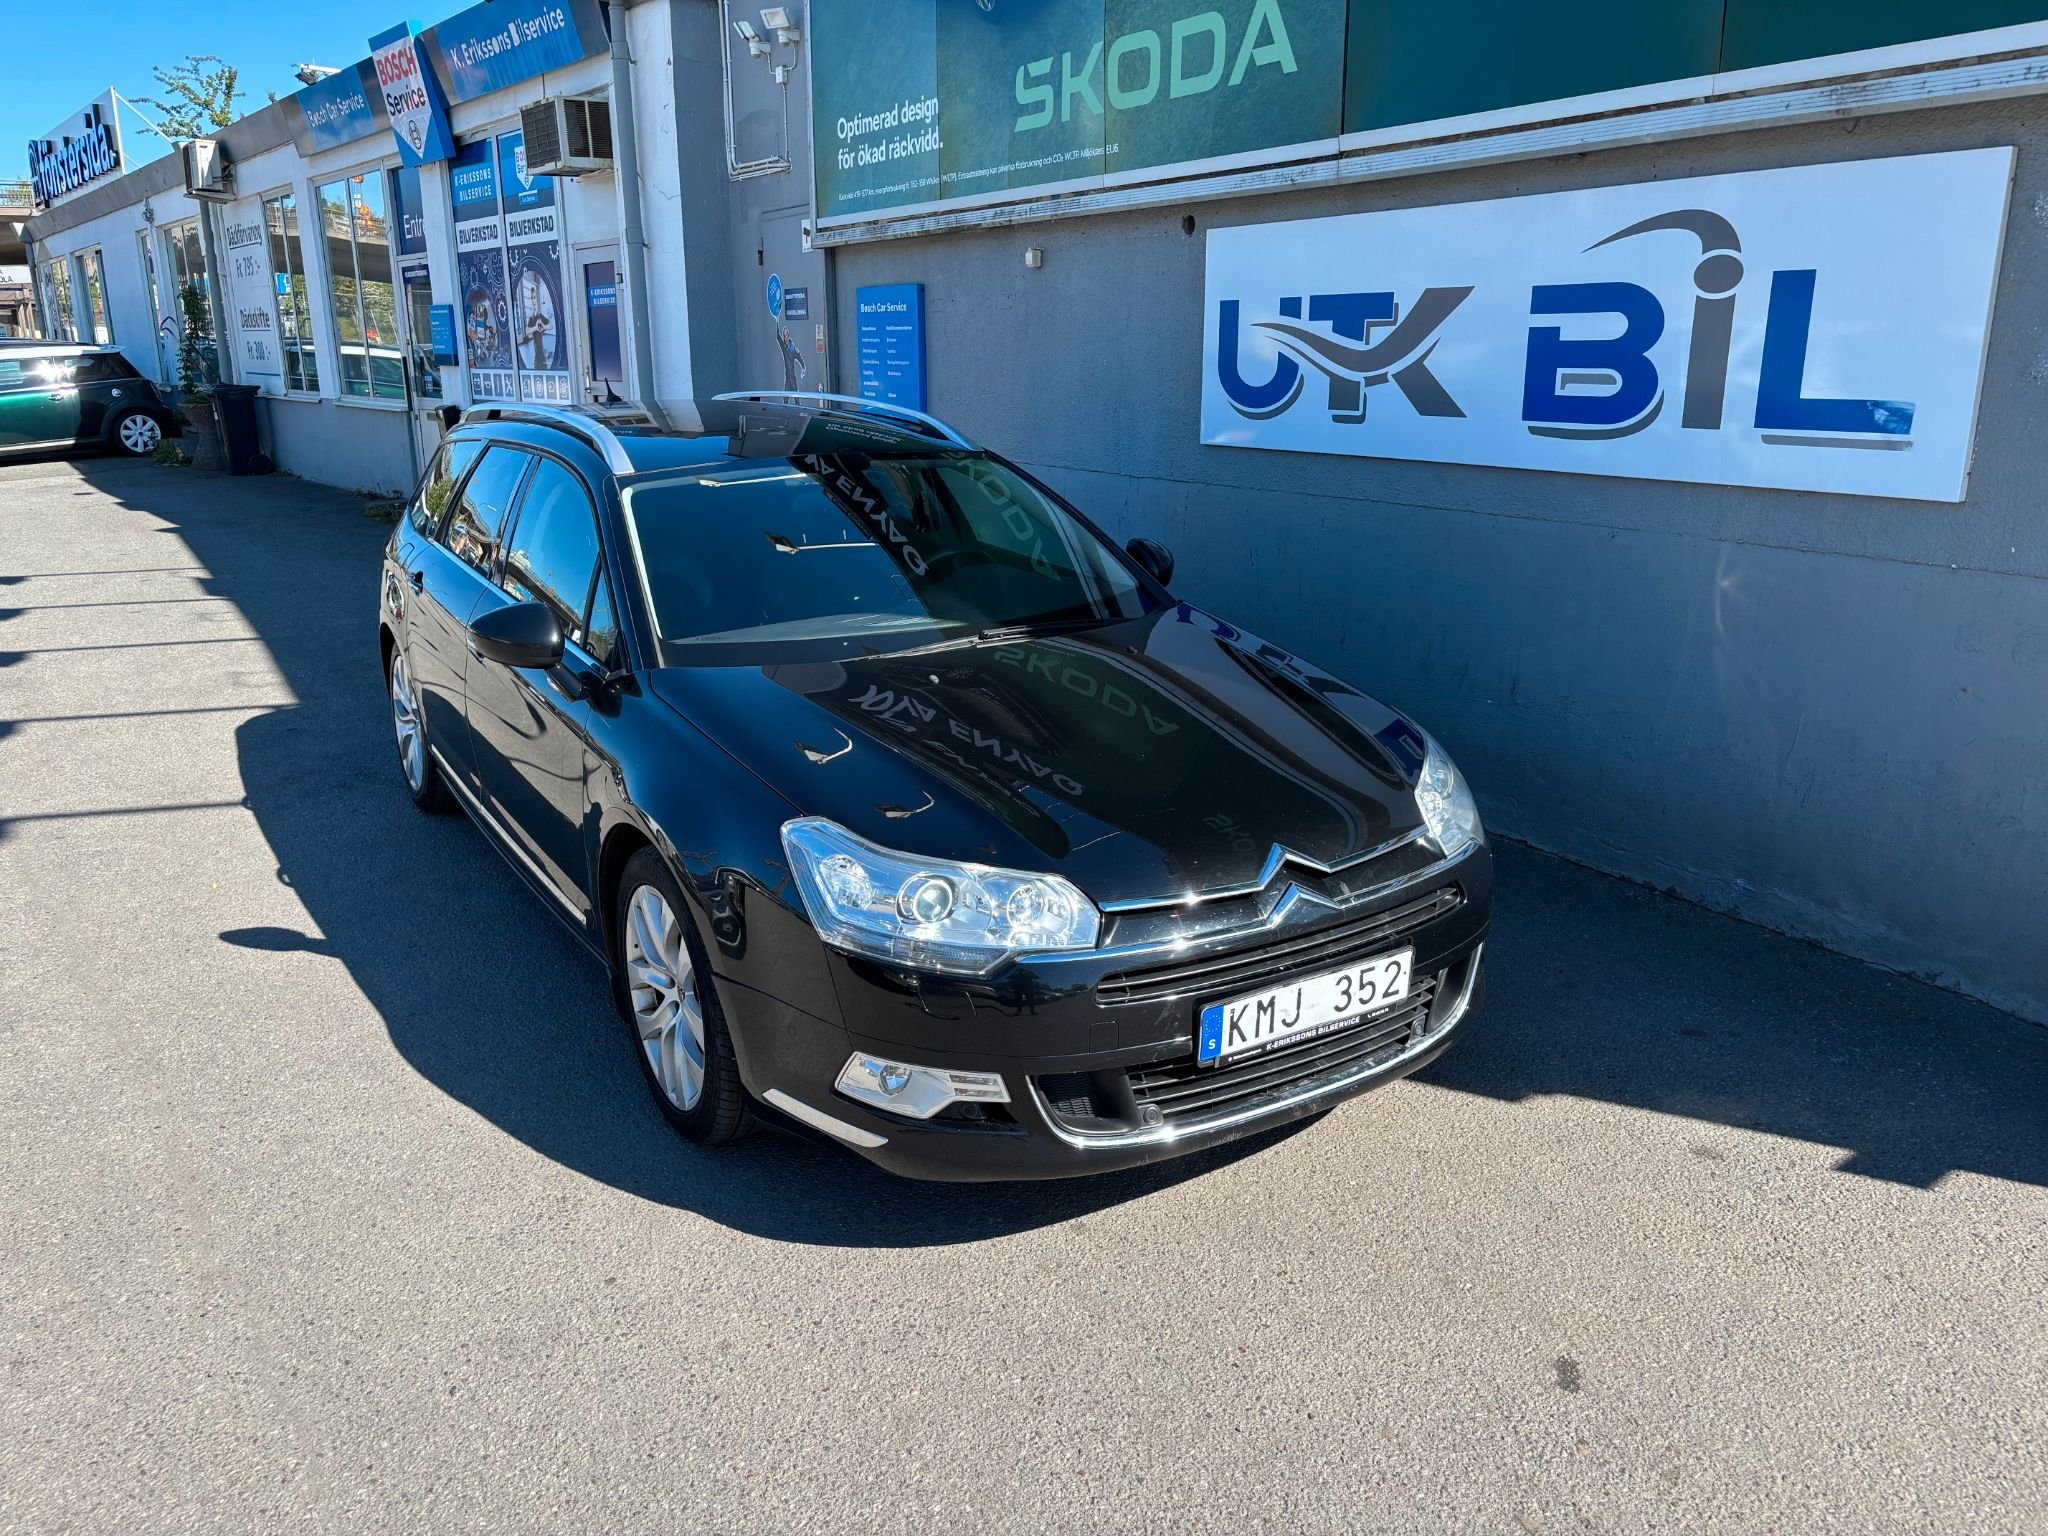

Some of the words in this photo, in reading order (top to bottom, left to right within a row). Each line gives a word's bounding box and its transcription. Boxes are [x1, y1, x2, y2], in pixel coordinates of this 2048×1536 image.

[461, 31, 512, 66] Erikssons
[508, 6, 565, 47] Bilservice
[376, 46, 418, 86] BOSCH
[307, 103, 328, 128] Bosch
[326, 102, 338, 120] Car
[337, 92, 365, 115] Service
[386, 84, 426, 116] Service
[837, 103, 898, 143] Optimerad
[901, 95, 939, 124] design
[838, 148, 855, 170] för
[857, 139, 886, 166] ökad
[889, 125, 944, 159] räckvidd.
[460, 185, 492, 202] BILSERVICE
[403, 213, 425, 239] Entr
[459, 224, 499, 245] BILVERKSTAD
[509, 215, 554, 238] BILVERKSTAD
[861, 303, 877, 313] Bosch
[877, 303, 886, 312] Car
[887, 301, 907, 312] Service
[1228, 987, 1302, 1047] KMJ
[1333, 960, 1402, 1013] 352
[1208, 1038, 1216, 1050] S
[1266, 1029, 1317, 1052] K-ERIKSSONS
[1317, 1016, 1361, 1036] BILSERVICE
